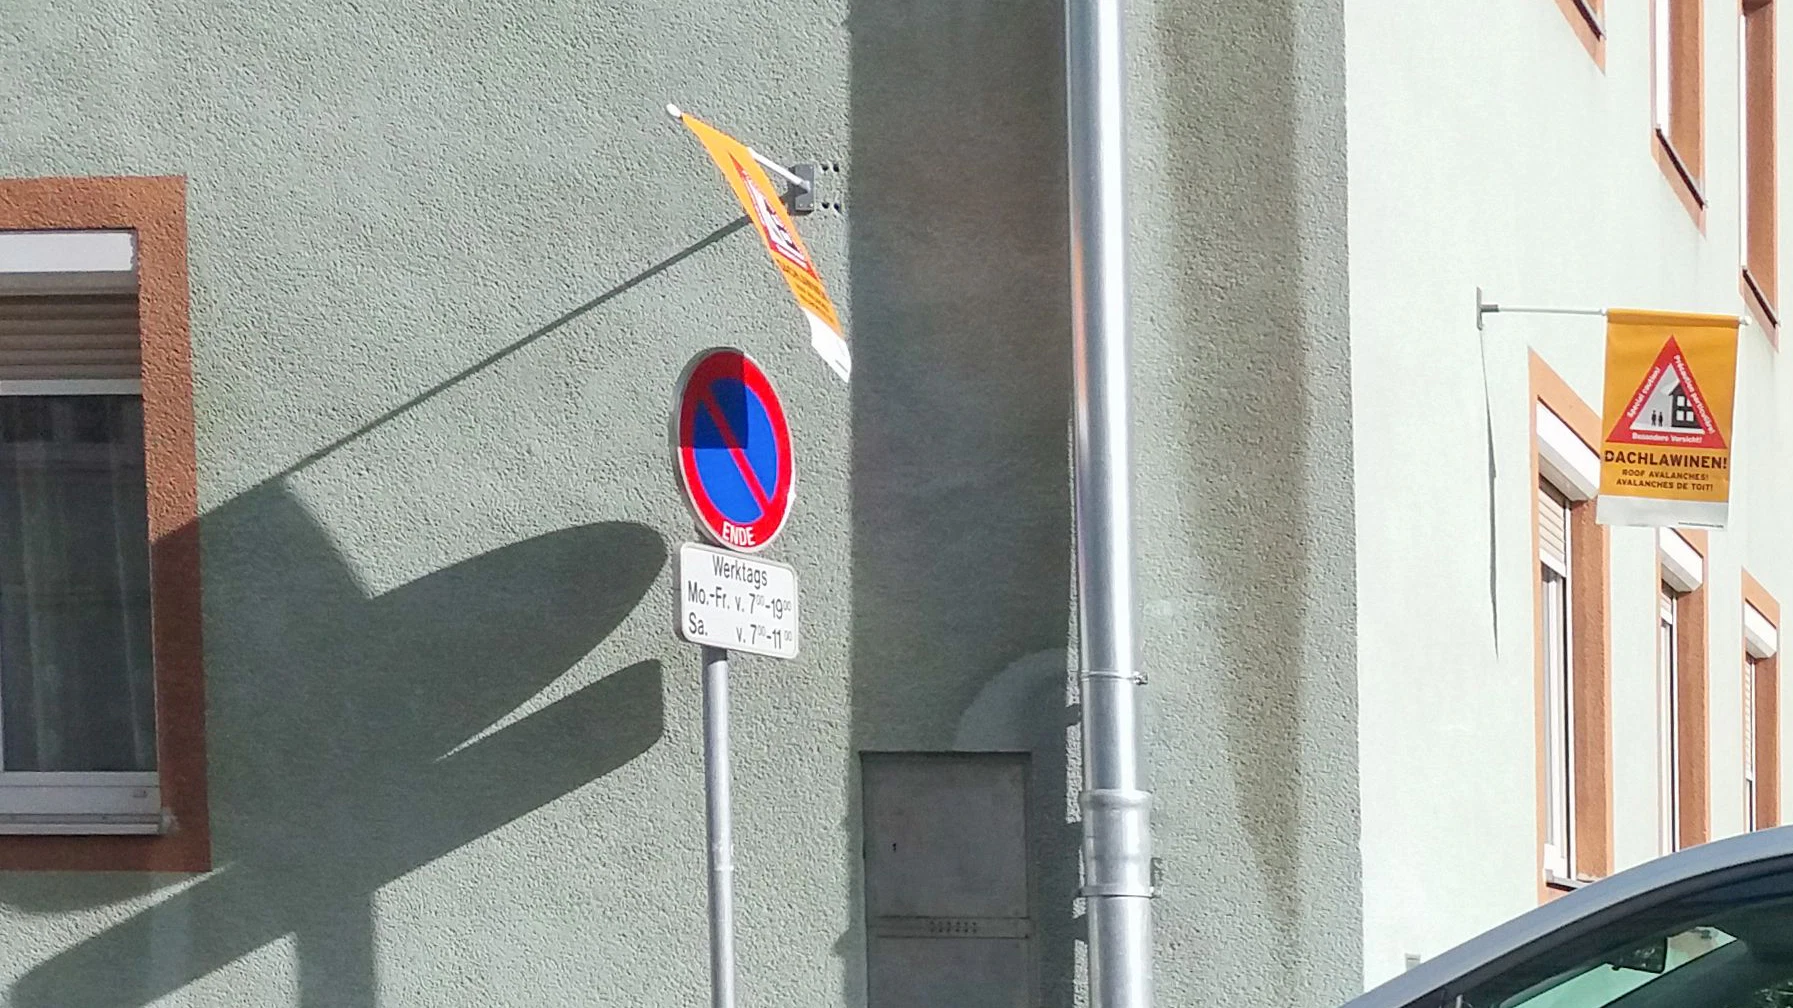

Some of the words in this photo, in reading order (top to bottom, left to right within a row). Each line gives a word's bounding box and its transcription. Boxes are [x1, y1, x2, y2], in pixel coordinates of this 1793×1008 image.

[1604, 450, 1728, 469] DACHLAWINEN!
[1616, 478, 1674, 489] AVALANCHES
[1676, 482, 1689, 490] DE
[1691, 483, 1714, 492] TOIT!
[1622, 469, 1646, 477] ROOF
[1648, 471, 1709, 481] AVALANCHES!
[722, 521, 756, 546] ENDE
[712, 554, 768, 590] Werktags
[688, 580, 730, 610] Mo.-Fr.
[735, 596, 745, 613] v.
[688, 611, 708, 637] Sa.
[736, 626, 746, 644] v.
